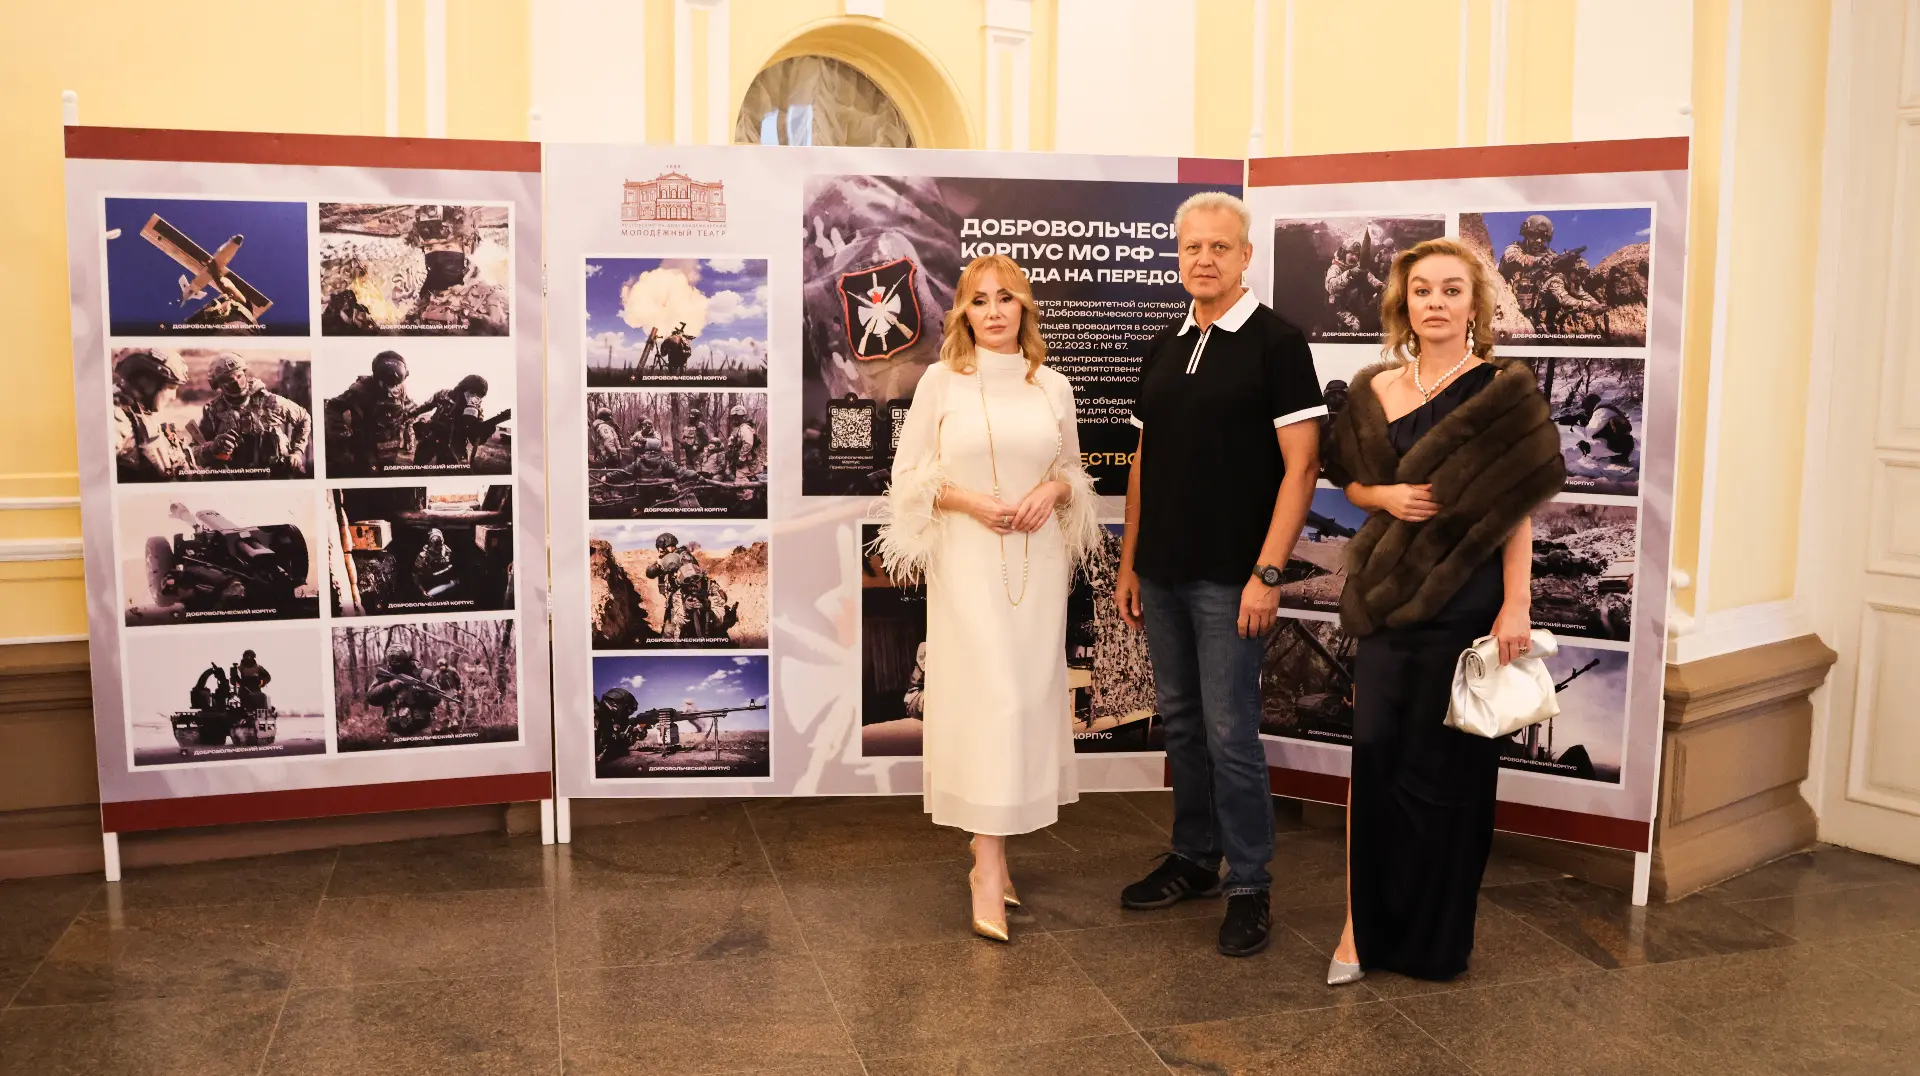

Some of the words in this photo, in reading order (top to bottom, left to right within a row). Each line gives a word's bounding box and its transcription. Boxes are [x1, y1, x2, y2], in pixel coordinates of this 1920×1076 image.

[621, 229, 692, 238] МОЛОДЁЖНЫЙ
[961, 242, 1063, 263] КОРПУС
[1068, 245, 1110, 263] МО
[1115, 245, 1154, 263] РФ
[1065, 269, 1093, 282] НА
[1097, 270, 1183, 286] ПЕРЕДО
[1063, 299, 1136, 310] приоритетной
[1138, 300, 1186, 309] системой
[1046, 309, 1142, 319] Добровольческого
[1144, 311, 1186, 320] корпус
[1038, 323, 1070, 331] льцев
[1072, 323, 1132, 333] проводится
[1042, 333, 1074, 342] истра
[1077, 332, 1122, 340] обороны
[1124, 332, 1156, 341] Росси
[1044, 342, 1091, 350] .02.2023
[1101, 342, 1112, 350] №
[1093, 397, 1136, 406] объедин
[1087, 408, 1106, 416] для
[1109, 407, 1132, 417] борь
[1077, 416, 1108, 424] енной
[178, 467, 245, 475] ДОБРОВОЛЬЧЕСКИЙ
[384, 463, 445, 471] ДОБРОВОЛЬЧЕСКИЙ
[388, 600, 449, 609] ДОБРОВОЛЬЧЕСКИЙ
[1313, 599, 1340, 607] ДОБРОВО
[185, 608, 250, 618] ДОБРОВОЛЬЧЕСКИЙ
[1531, 620, 1560, 628] ЬЧЕСКИЙ
[393, 733, 454, 742] ДОБРОВОЛЬЧЕСКИЙ
[1308, 729, 1353, 740] ДОБРОВОЛЬЧЕС
[193, 746, 258, 756] ДОБРОВОЛЬЧЕСКИЙ
[1500, 755, 1552, 767] БРОВОЛЬЧЕСКИЙ
[1553, 762, 1578, 771] КОРПУС
